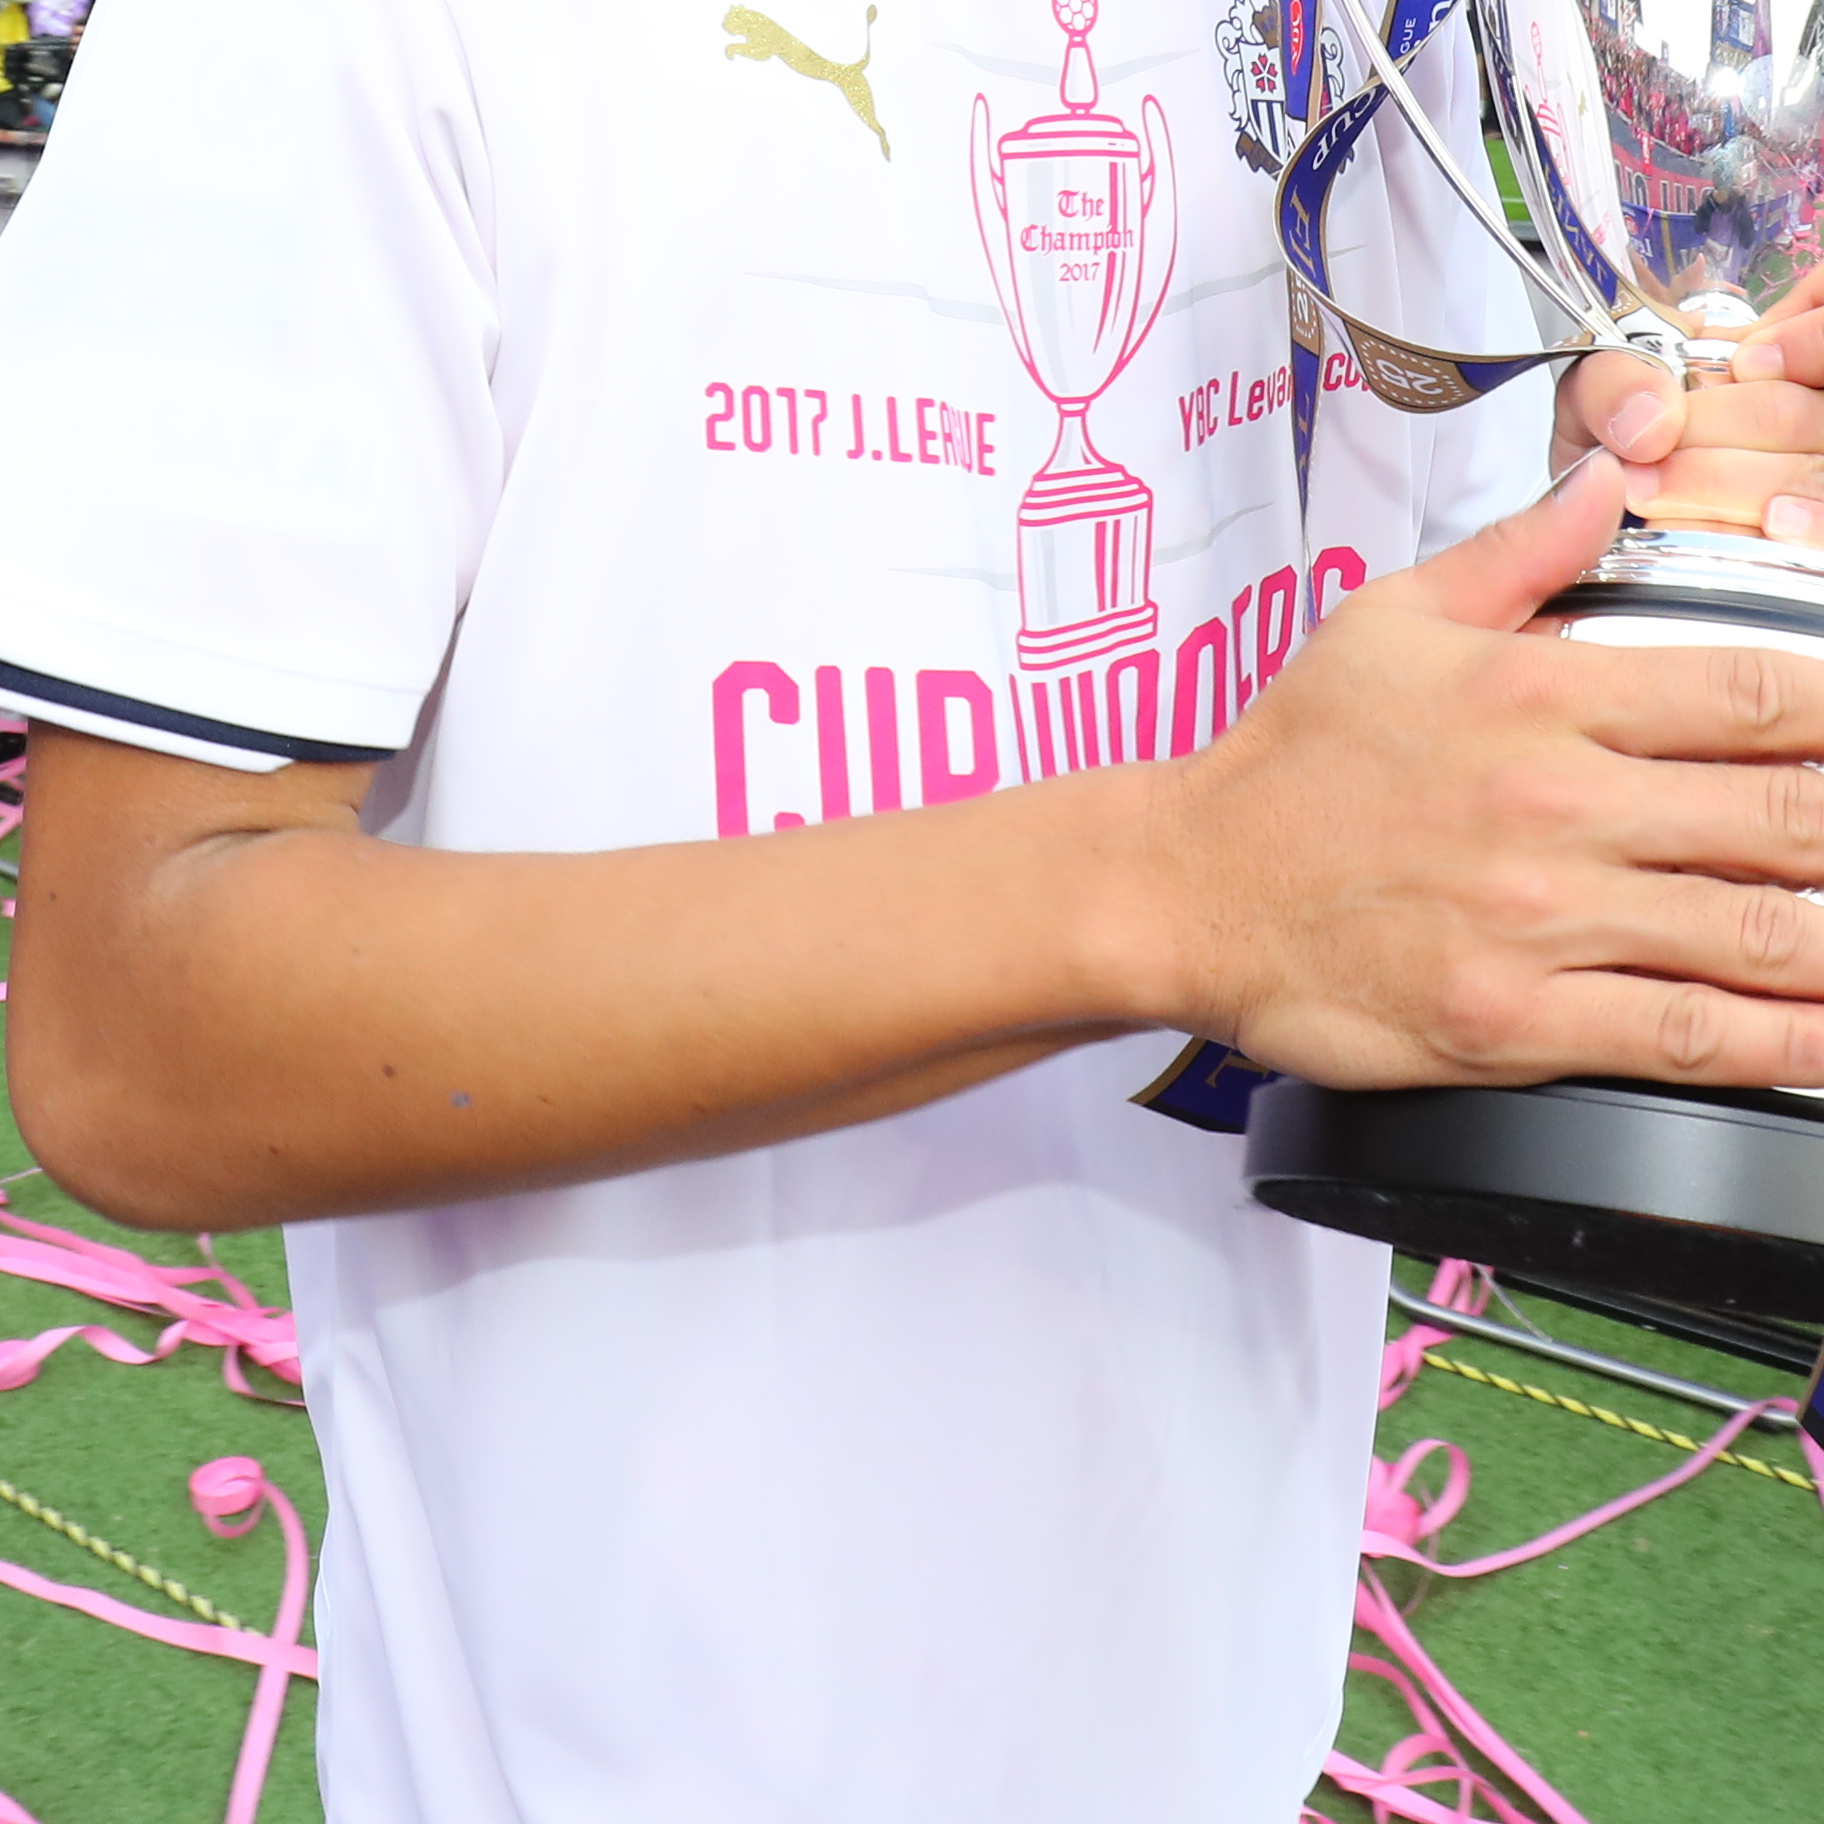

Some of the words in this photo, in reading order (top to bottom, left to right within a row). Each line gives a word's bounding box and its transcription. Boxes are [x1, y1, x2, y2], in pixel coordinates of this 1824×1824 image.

[1057, 190, 1104, 222] The
[1020, 224, 1134, 257] Champion
[1059, 262, 1100, 282] 2017
[706, 383, 827, 456] 2017
[847, 393, 996, 475] J.LEAUE
[1178, 378, 1220, 452] YBC
[711, 660, 1000, 840] CUP
